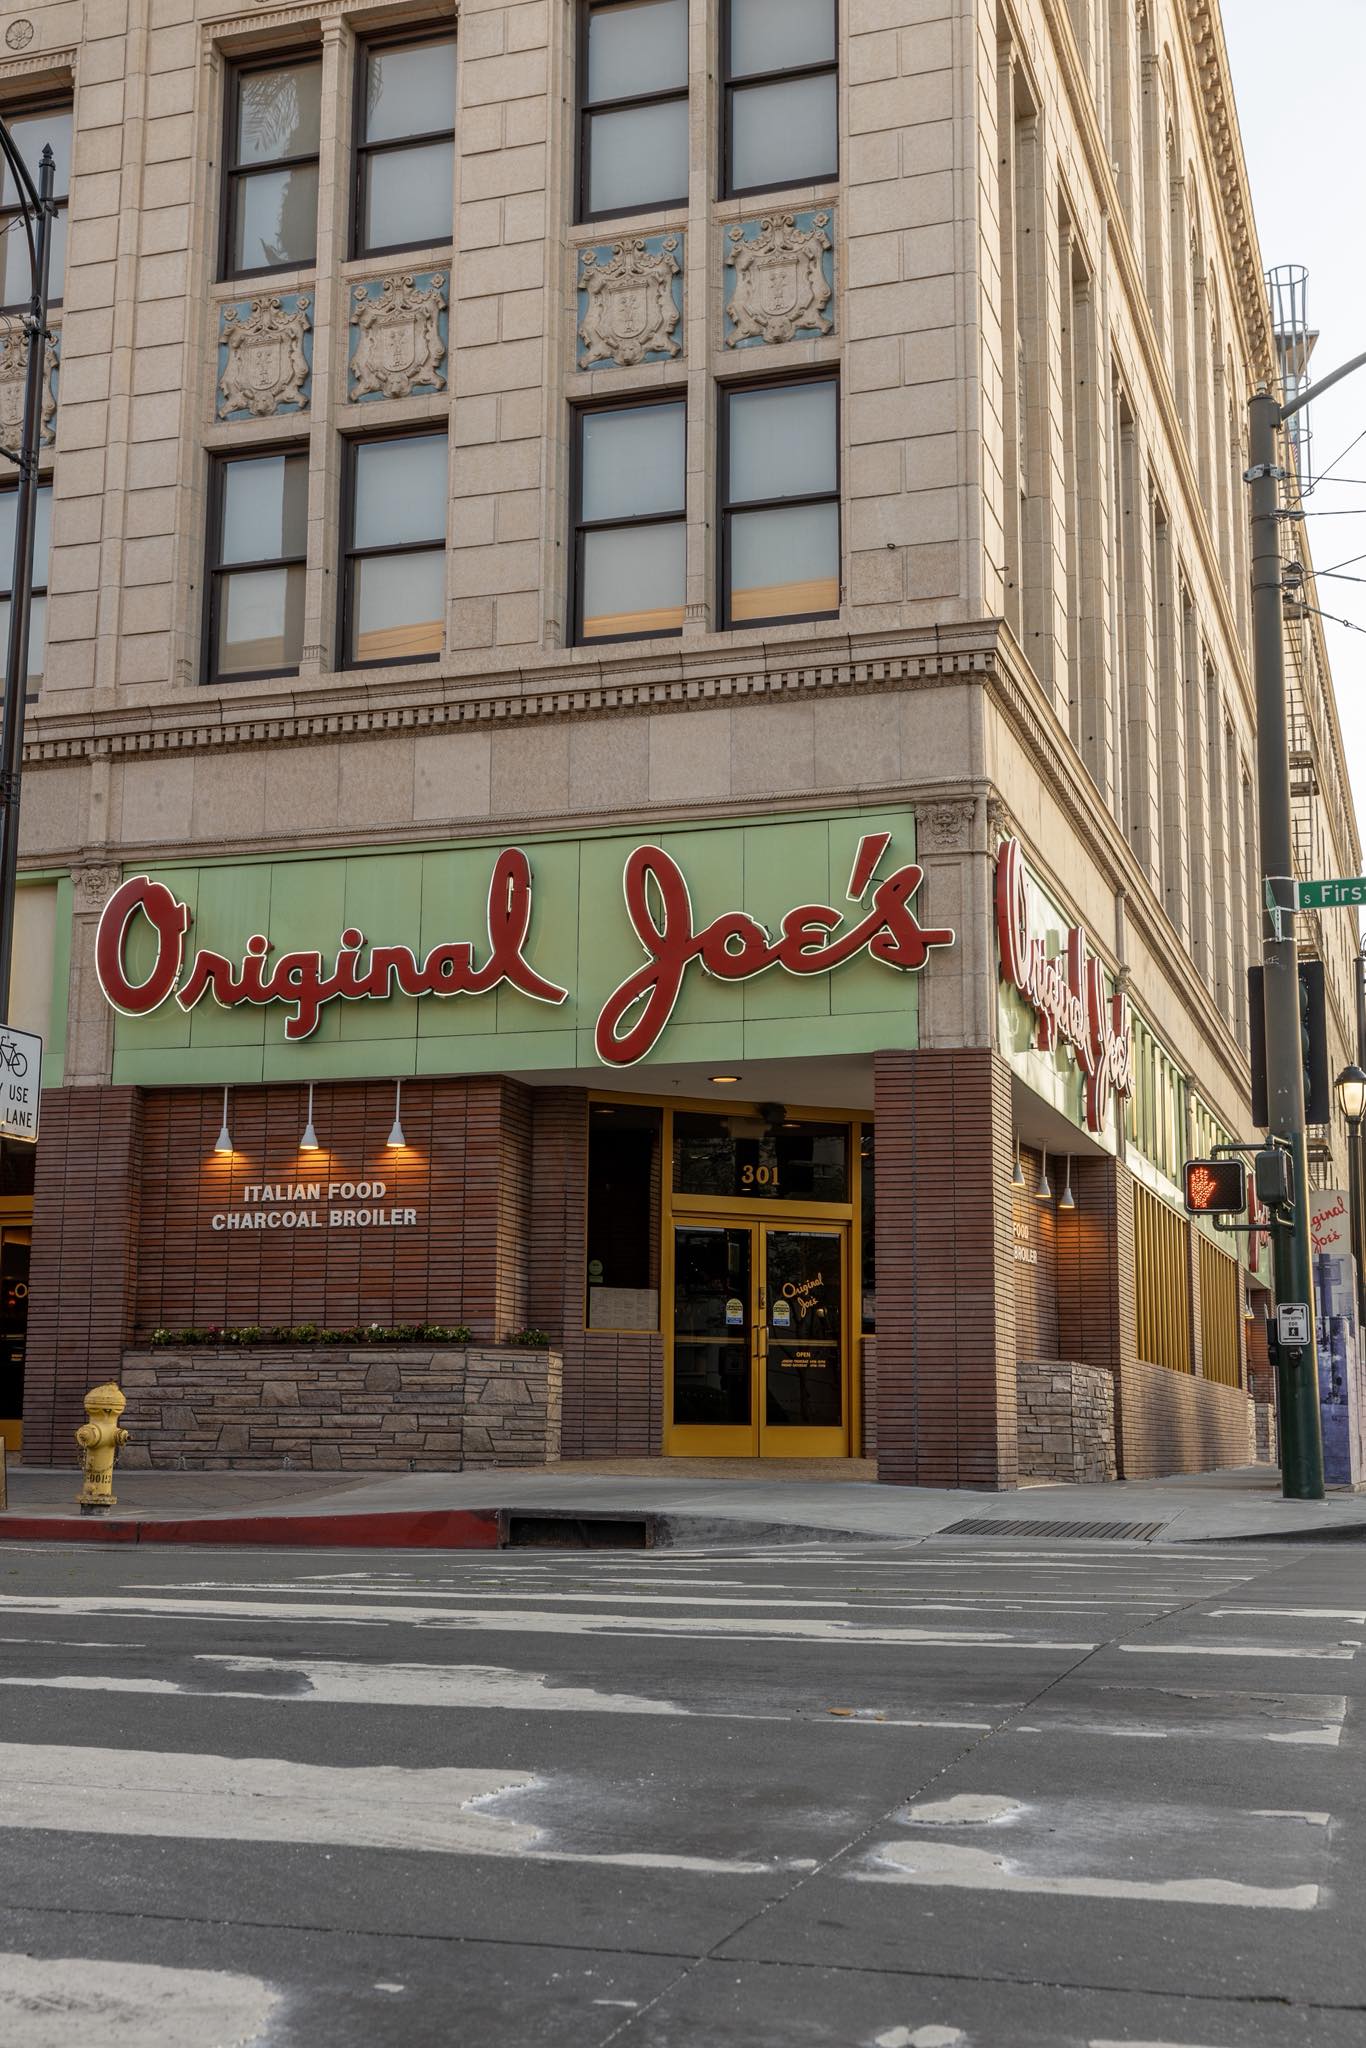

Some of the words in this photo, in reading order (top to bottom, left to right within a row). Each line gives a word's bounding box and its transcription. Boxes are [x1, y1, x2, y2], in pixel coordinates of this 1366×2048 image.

[1321, 884, 1366, 903] Firs
[95, 847, 569, 1040] Original
[595, 832, 954, 1068] Joe's
[9, 1083, 29, 1104] USE
[6, 1107, 33, 1129] LANE
[741, 1164, 780, 1185] 301
[243, 1184, 321, 1202] ITALIAN
[328, 1181, 387, 1200] FOOD
[211, 1210, 322, 1231] CHARCOAL
[329, 1208, 417, 1227] BROILER
[1310, 1196, 1349, 1232] ginal
[782, 1272, 824, 1298] Original
[797, 1296, 820, 1318] Joe's
